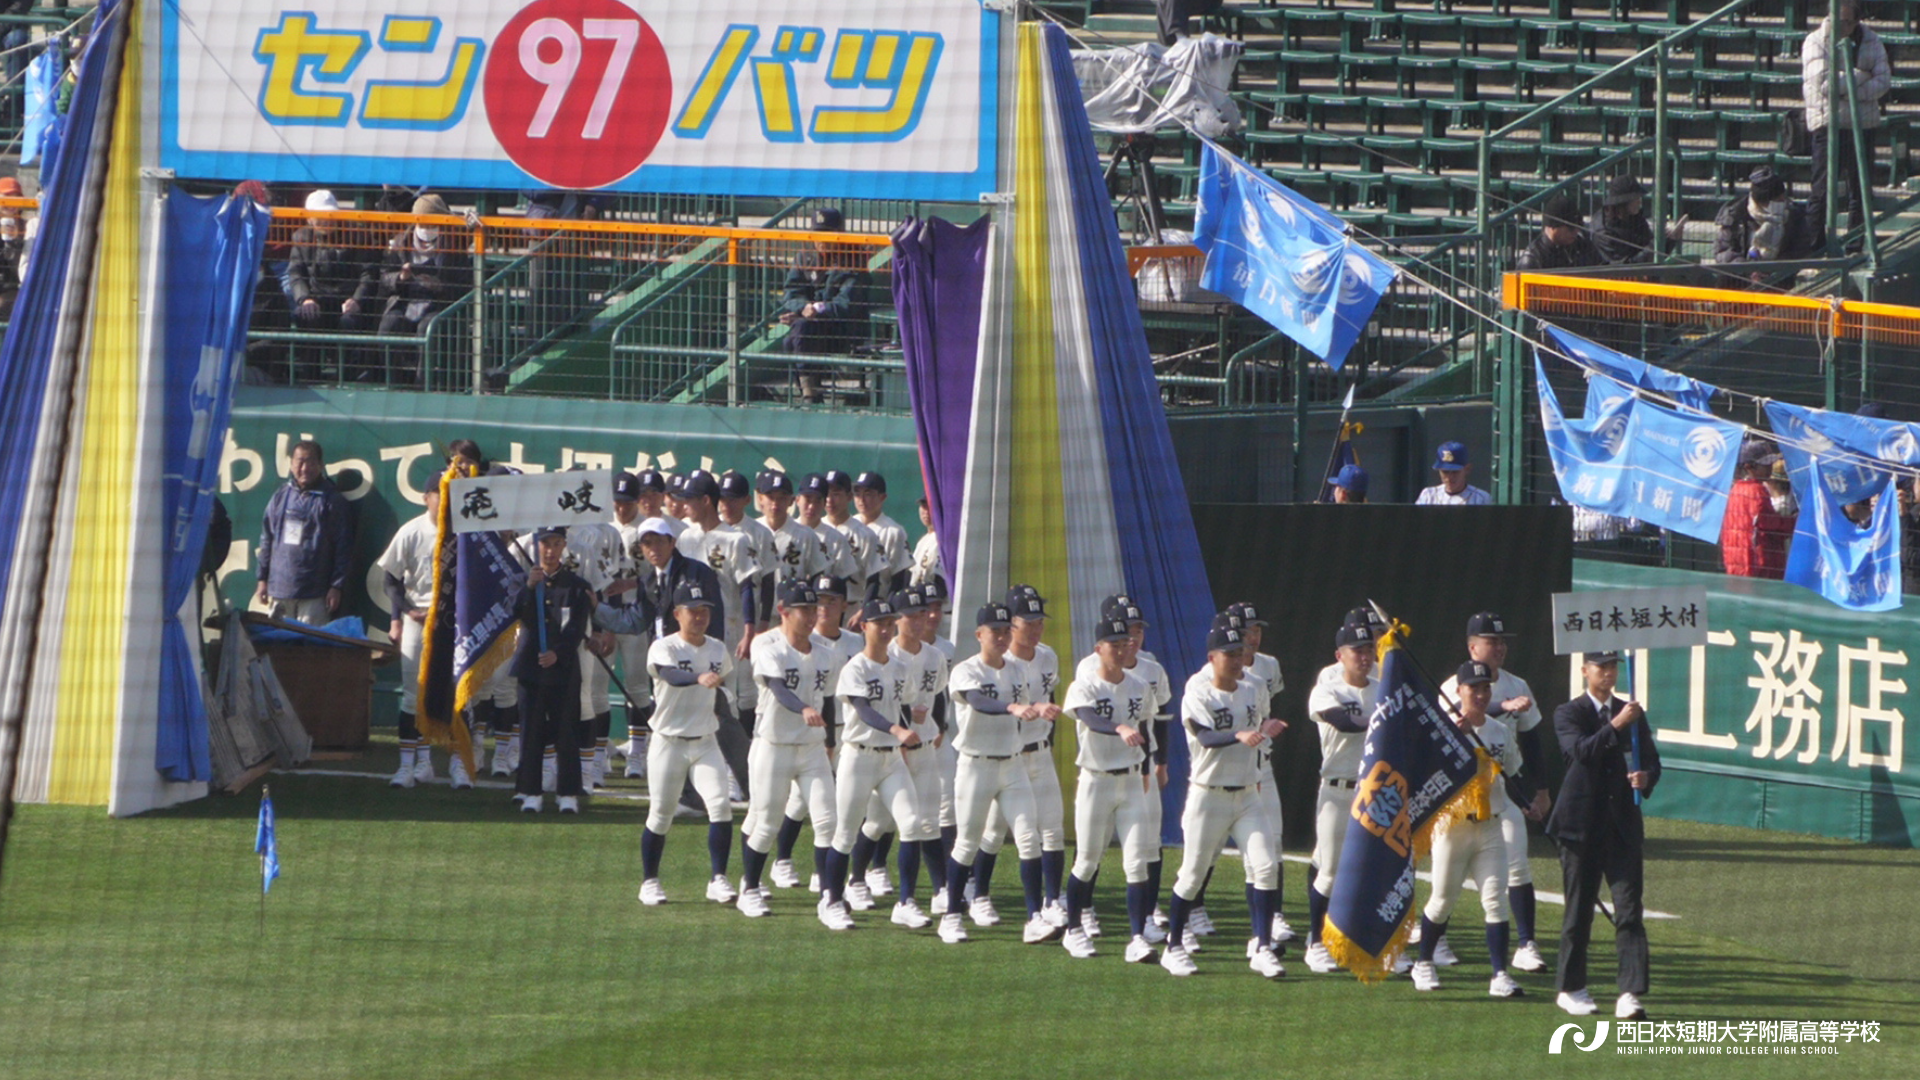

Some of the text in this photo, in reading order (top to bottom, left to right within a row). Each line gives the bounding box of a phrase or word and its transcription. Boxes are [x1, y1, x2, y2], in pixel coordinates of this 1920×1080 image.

[252, 11, 945, 143] セン 97 バツ
[1562, 603, 1700, 633] 西日本短大付
